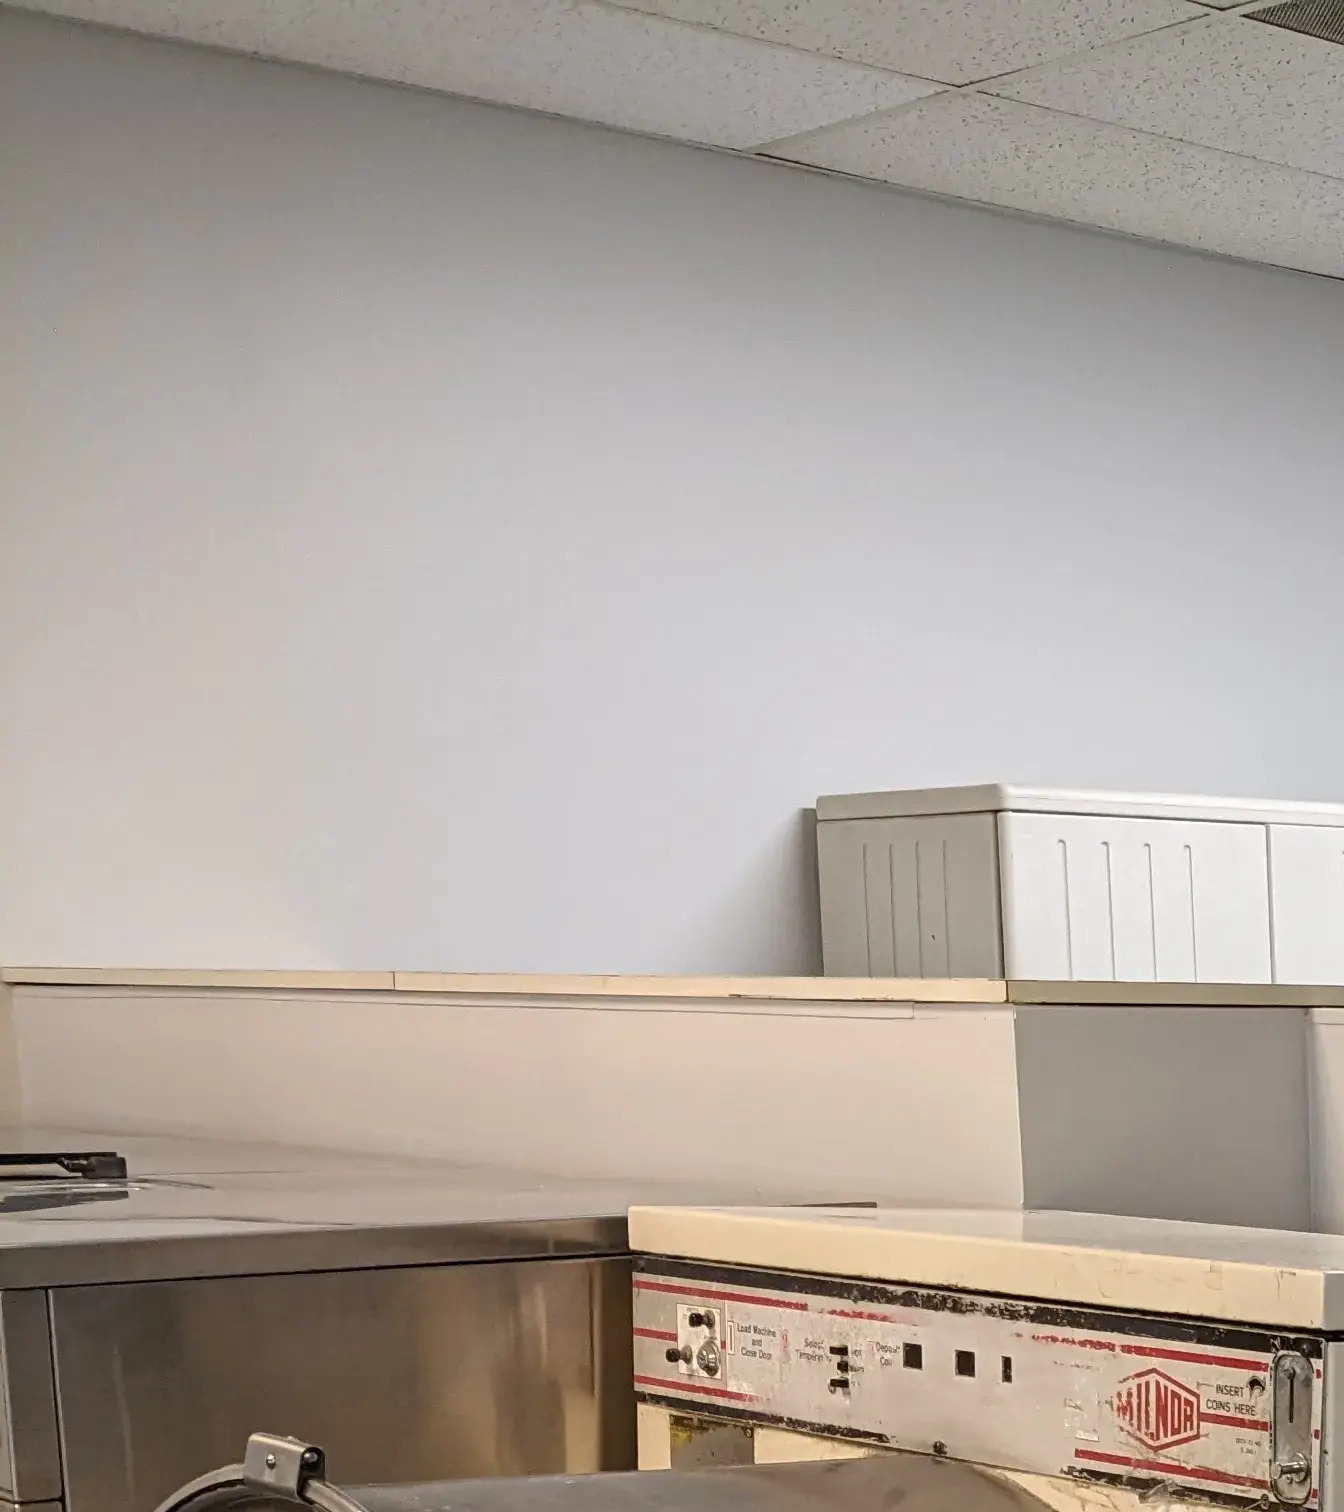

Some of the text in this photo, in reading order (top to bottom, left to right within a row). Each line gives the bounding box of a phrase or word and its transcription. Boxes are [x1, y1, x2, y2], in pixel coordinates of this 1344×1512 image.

[1216, 1384, 1244, 1398] INSERT
[1116, 1379, 1194, 1441] MILNOR
[1206, 1399, 1256, 1417] COINS HERE
